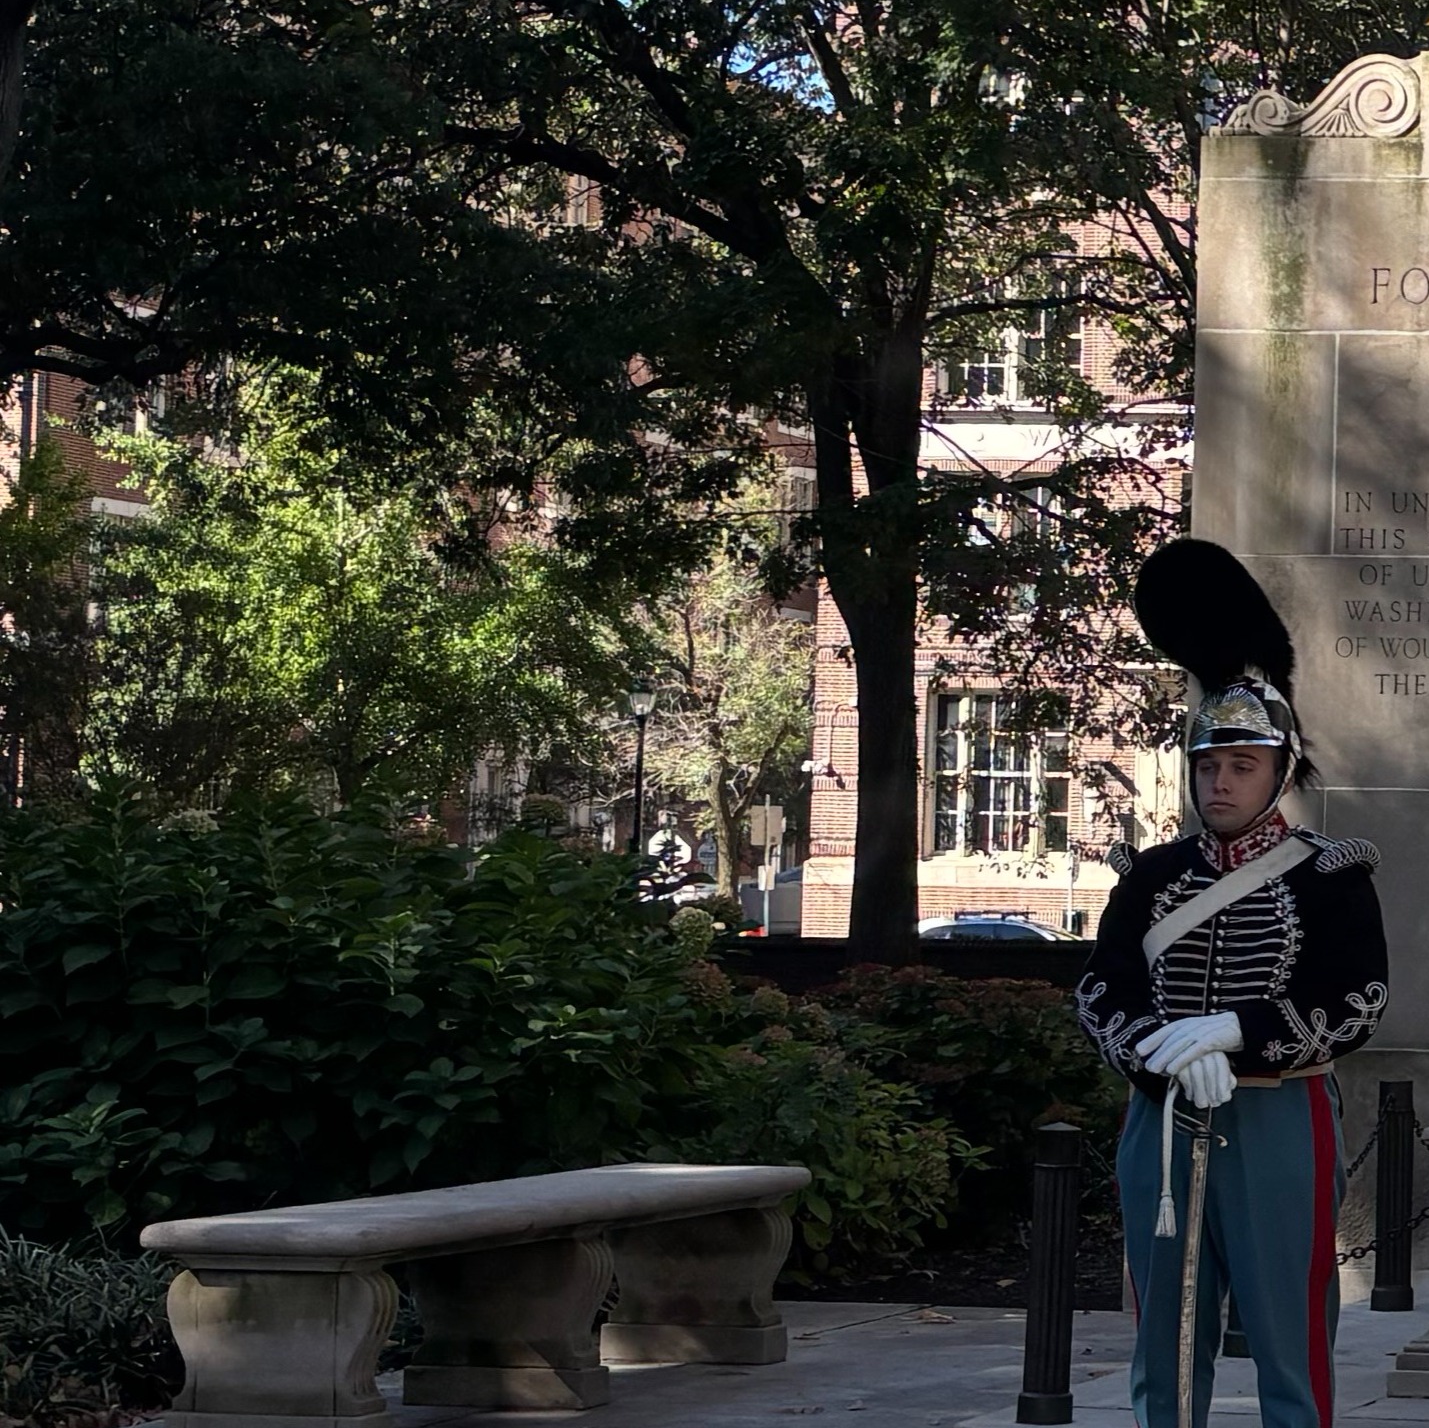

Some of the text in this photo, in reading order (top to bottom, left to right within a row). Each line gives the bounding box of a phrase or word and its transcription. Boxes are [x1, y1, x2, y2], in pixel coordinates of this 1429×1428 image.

[1344, 491, 1373, 513] IN
[1339, 527, 1406, 550] THIS
[1359, 564, 1393, 586] OF
[1335, 636, 1368, 658] OF
[1374, 673, 1428, 696] THE
